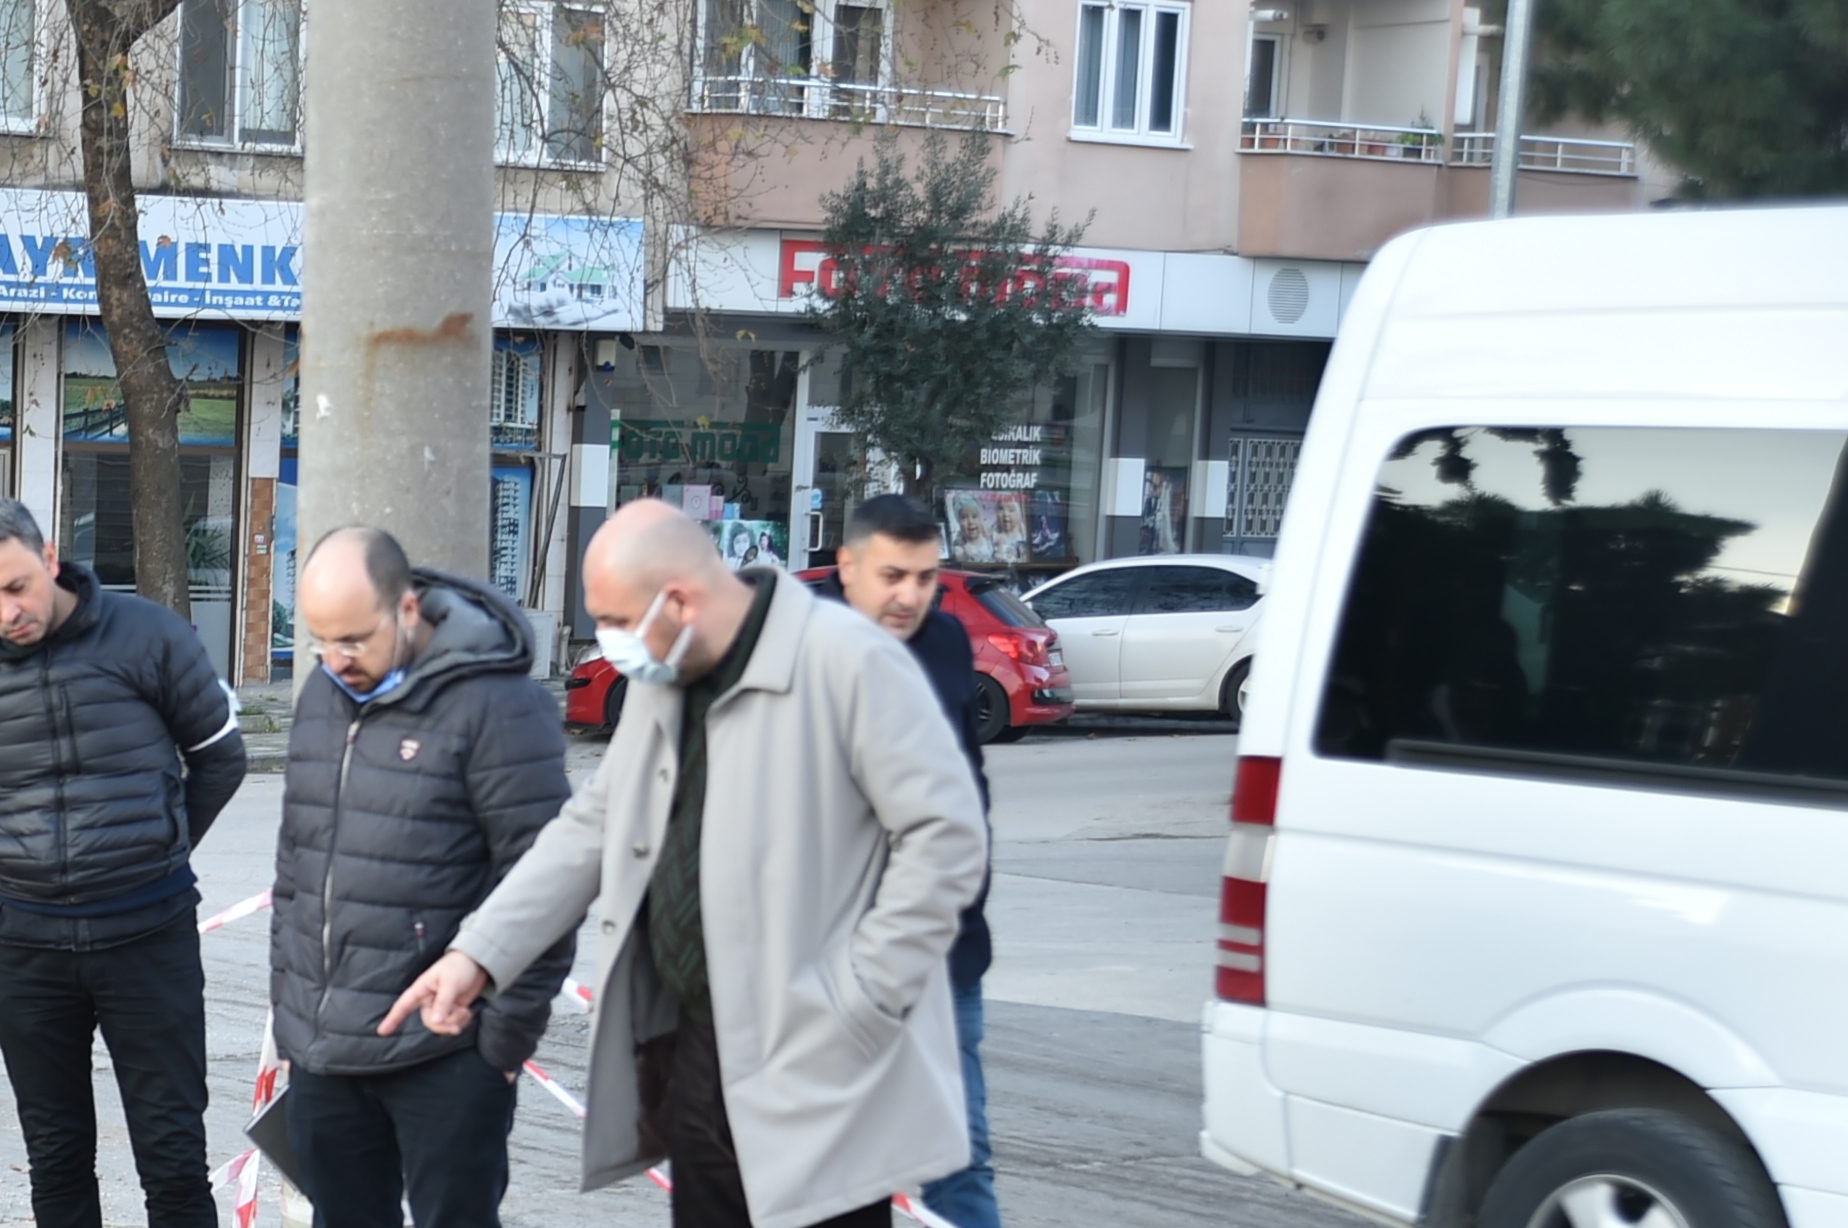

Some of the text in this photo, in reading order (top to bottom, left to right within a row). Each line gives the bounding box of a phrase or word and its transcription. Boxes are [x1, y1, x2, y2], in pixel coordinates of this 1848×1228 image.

[149, 291, 189, 304] aire
[205, 290, 264, 308] İnşaat
[979, 469, 1039, 489] FOTOĞRAF
